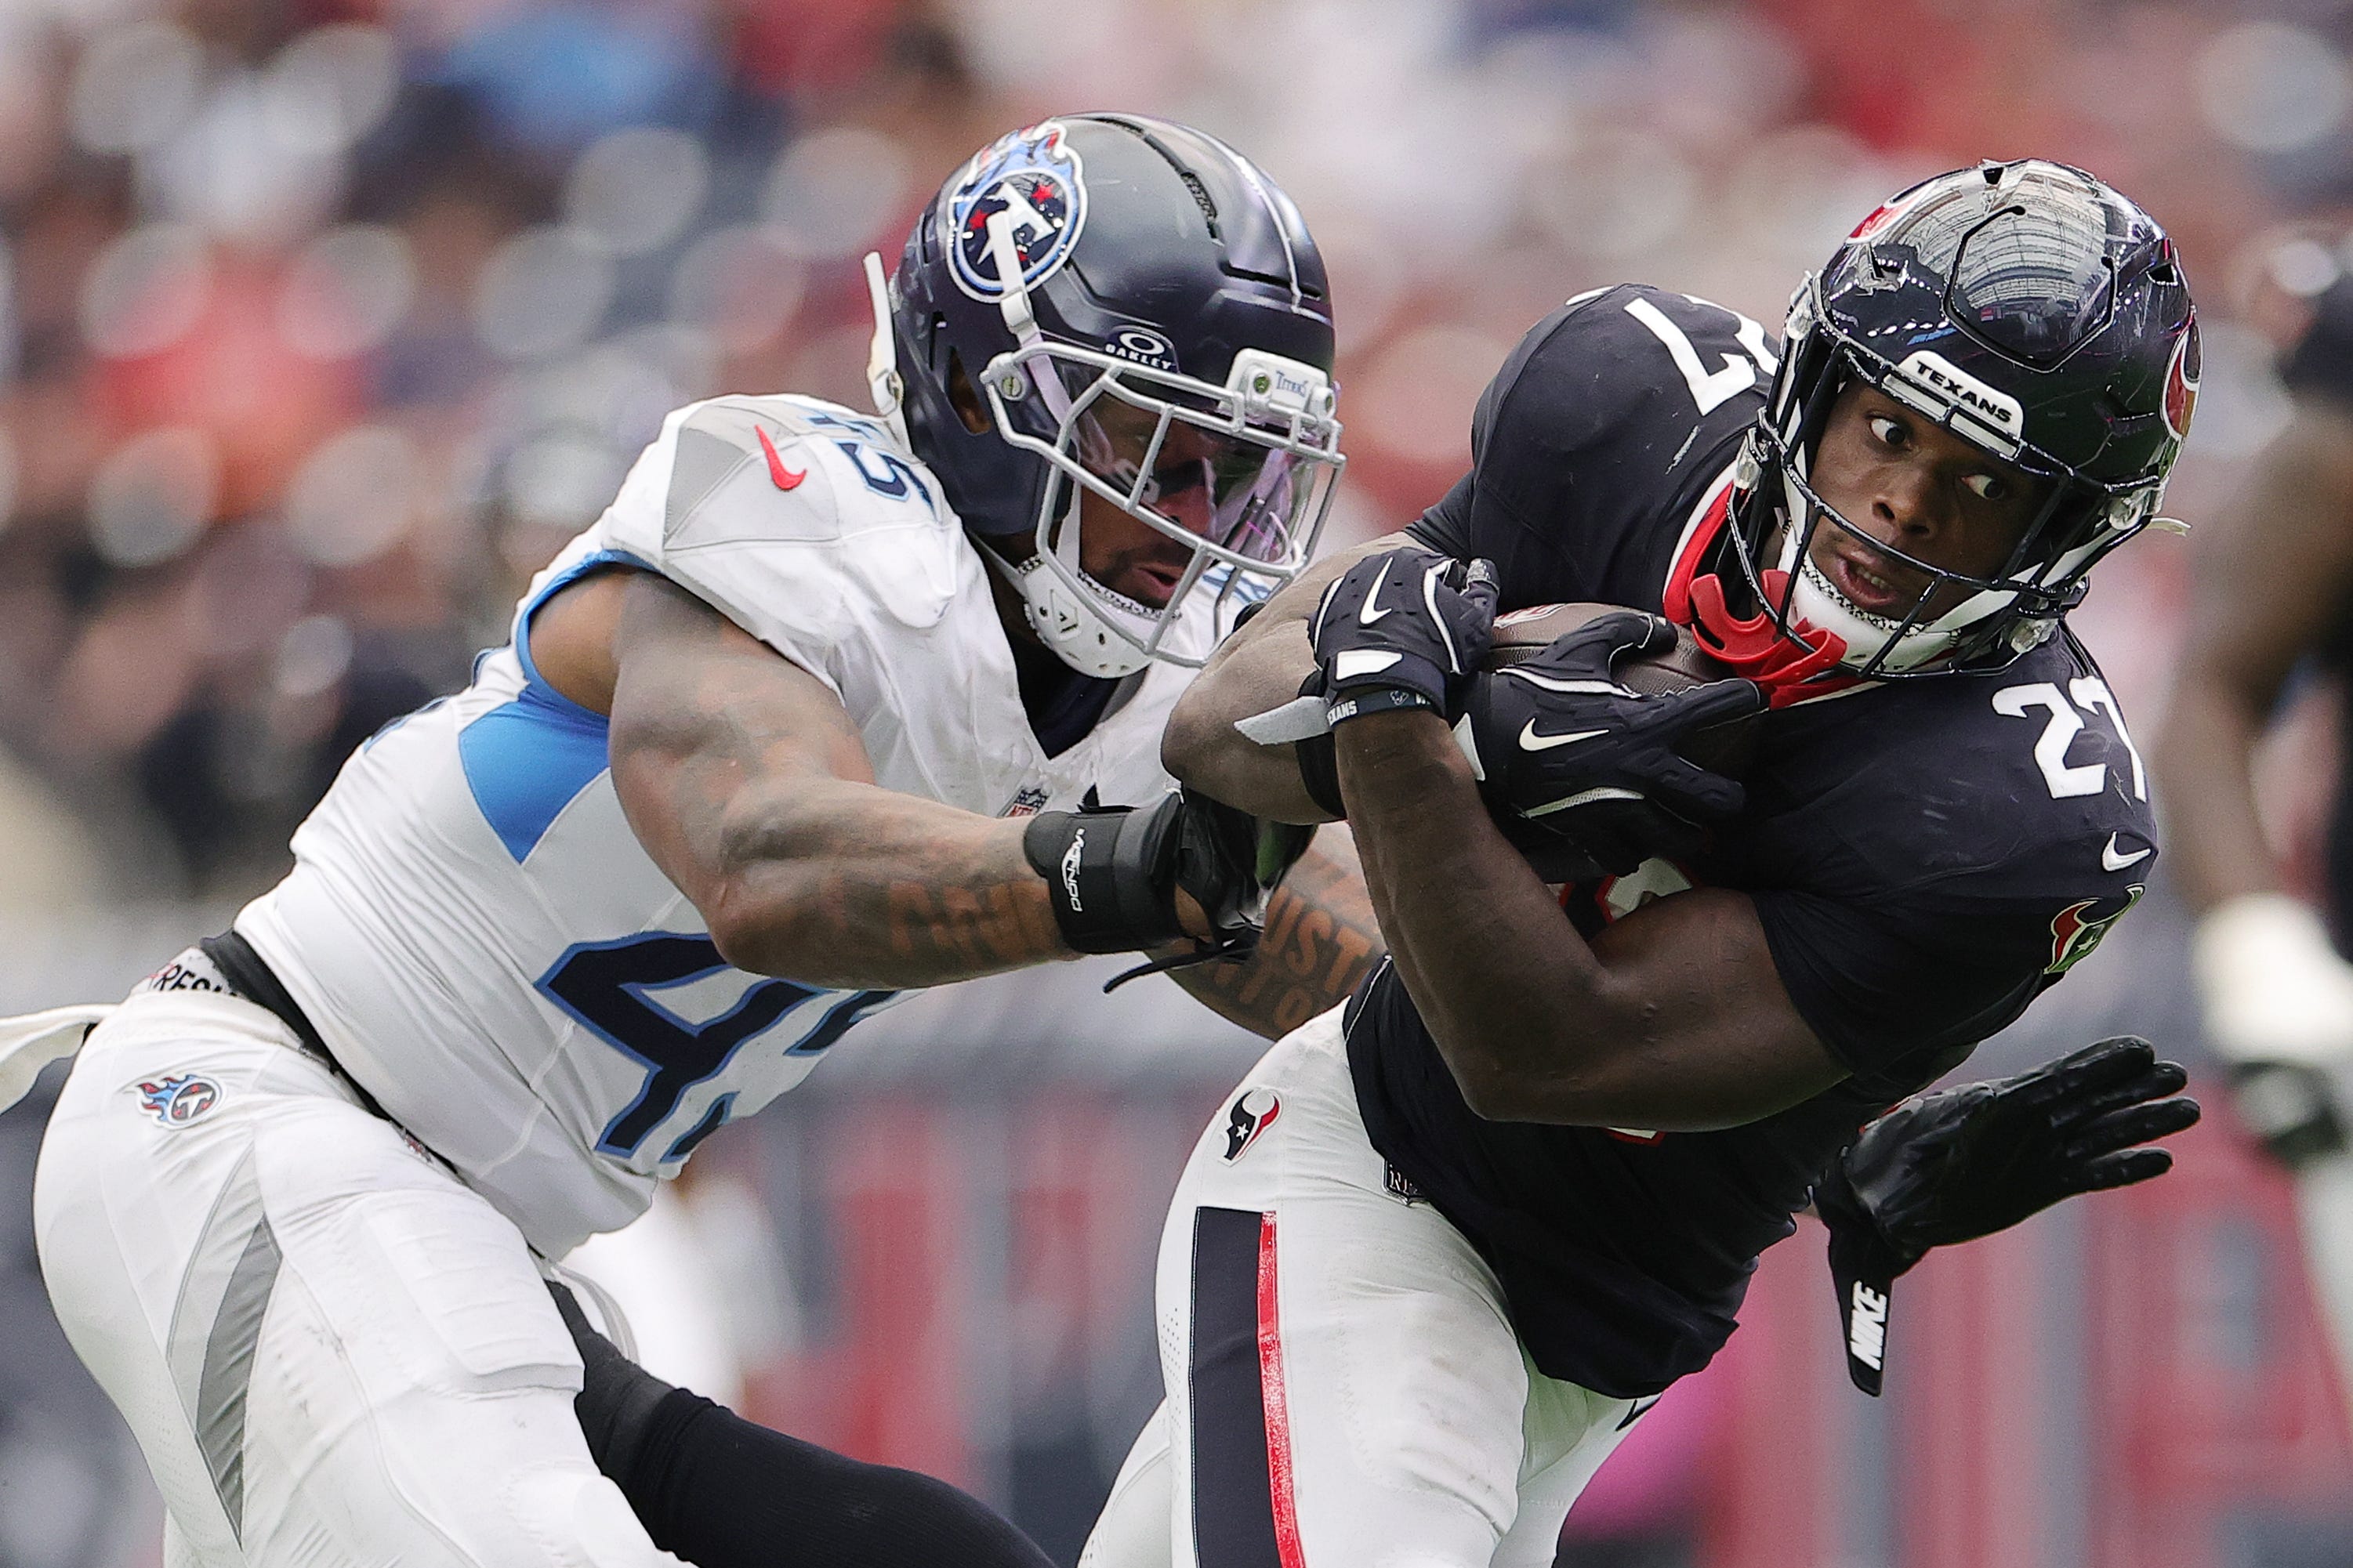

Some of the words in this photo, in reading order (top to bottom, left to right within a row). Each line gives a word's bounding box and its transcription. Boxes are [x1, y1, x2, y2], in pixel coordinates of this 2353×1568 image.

[1104, 343, 1172, 370] OAKLEY
[1916, 360, 2013, 423] TEXANS
[1326, 700, 1358, 727] EXANS
[1992, 676, 2147, 803] 27
[1850, 1280, 1887, 1371] NIKE
